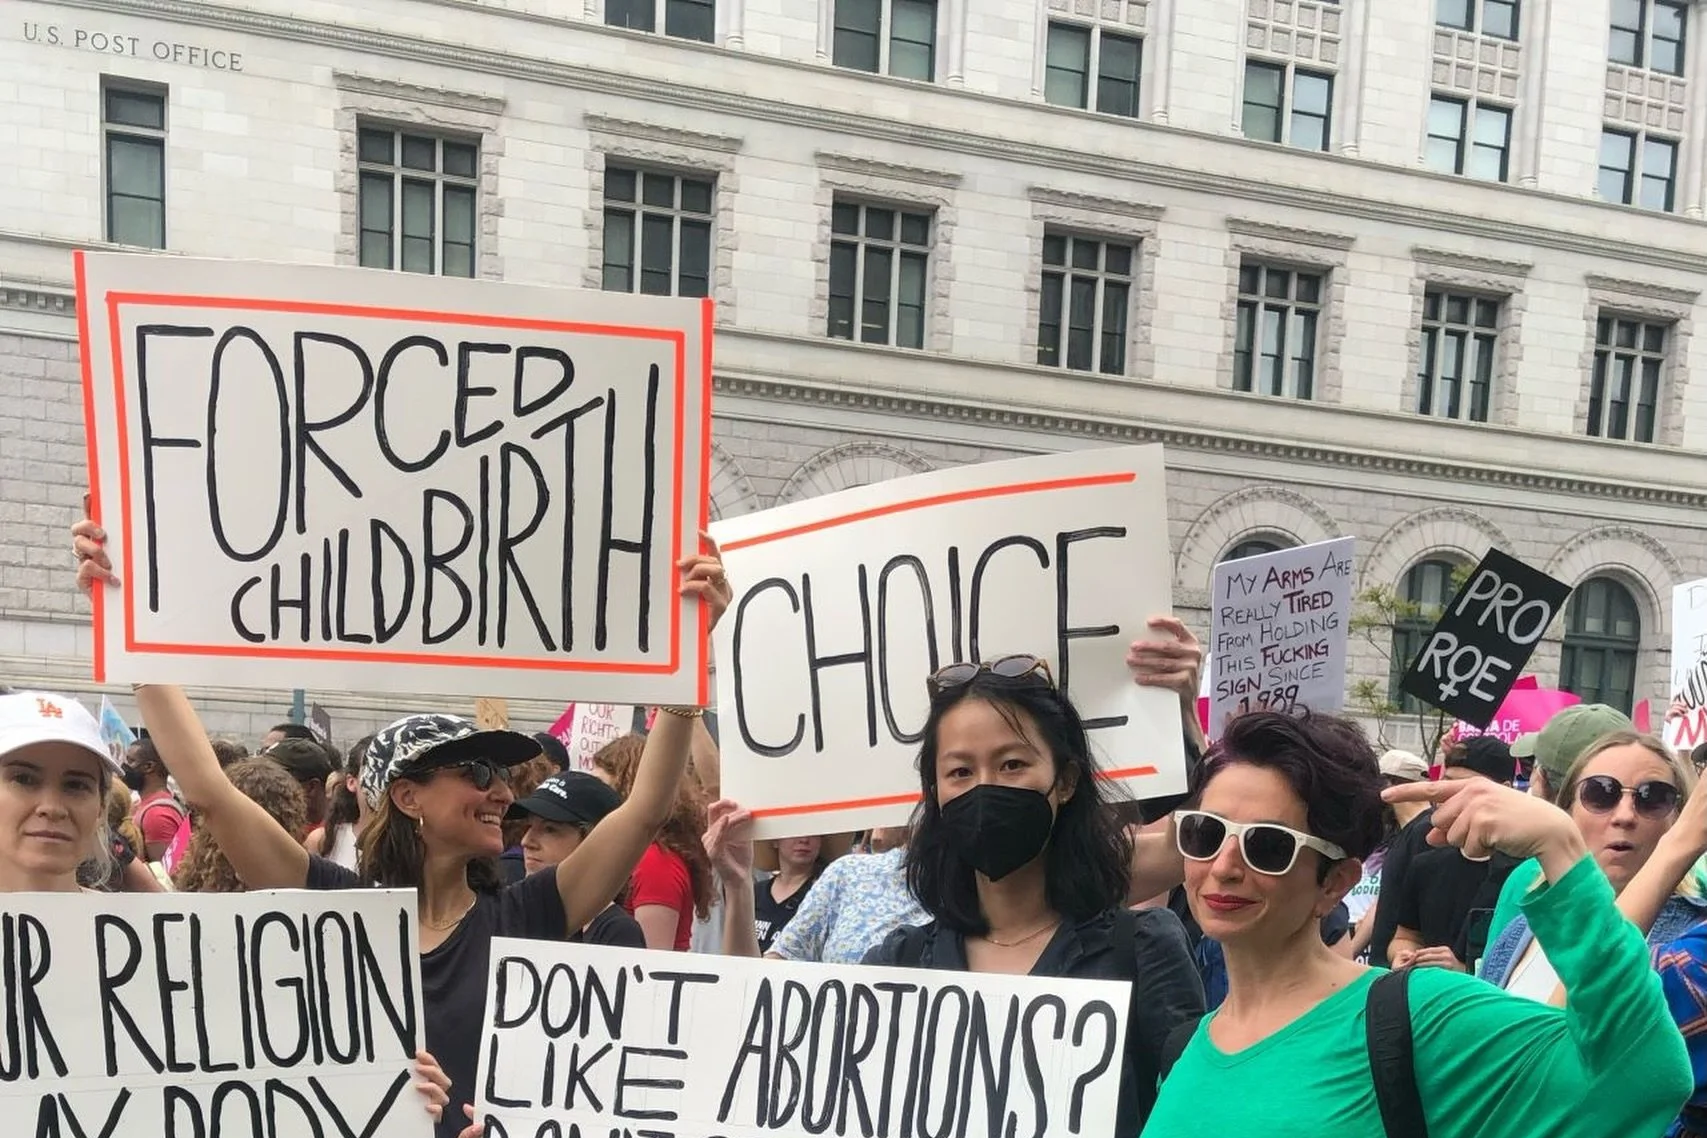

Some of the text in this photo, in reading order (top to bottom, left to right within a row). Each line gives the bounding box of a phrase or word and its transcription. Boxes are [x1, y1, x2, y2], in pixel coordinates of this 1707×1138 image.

[75, 29, 140, 57] POST
[152, 41, 243, 71] OFFICE
[136, 324, 575, 612] FORCED
[230, 363, 660, 653] CHILDBIRTH
[1262, 566, 1314, 593] ARMS
[1318, 551, 1352, 580] ARE
[1218, 612, 1339, 652] FROM HOLDING
[1221, 589, 1333, 627] REALLY TIRED
[1455, 569, 1551, 645] PRO
[1216, 638, 1329, 676] THIS FUCKING
[1216, 661, 1326, 702] SIGN SINCE
[1417, 631, 1512, 702] ROE
[1503, 719, 1520, 732] DE
[0, 907, 417, 1081] UR RELIGION
[494, 956, 719, 1045] DON'T
[484, 1033, 689, 1121] LIKE
